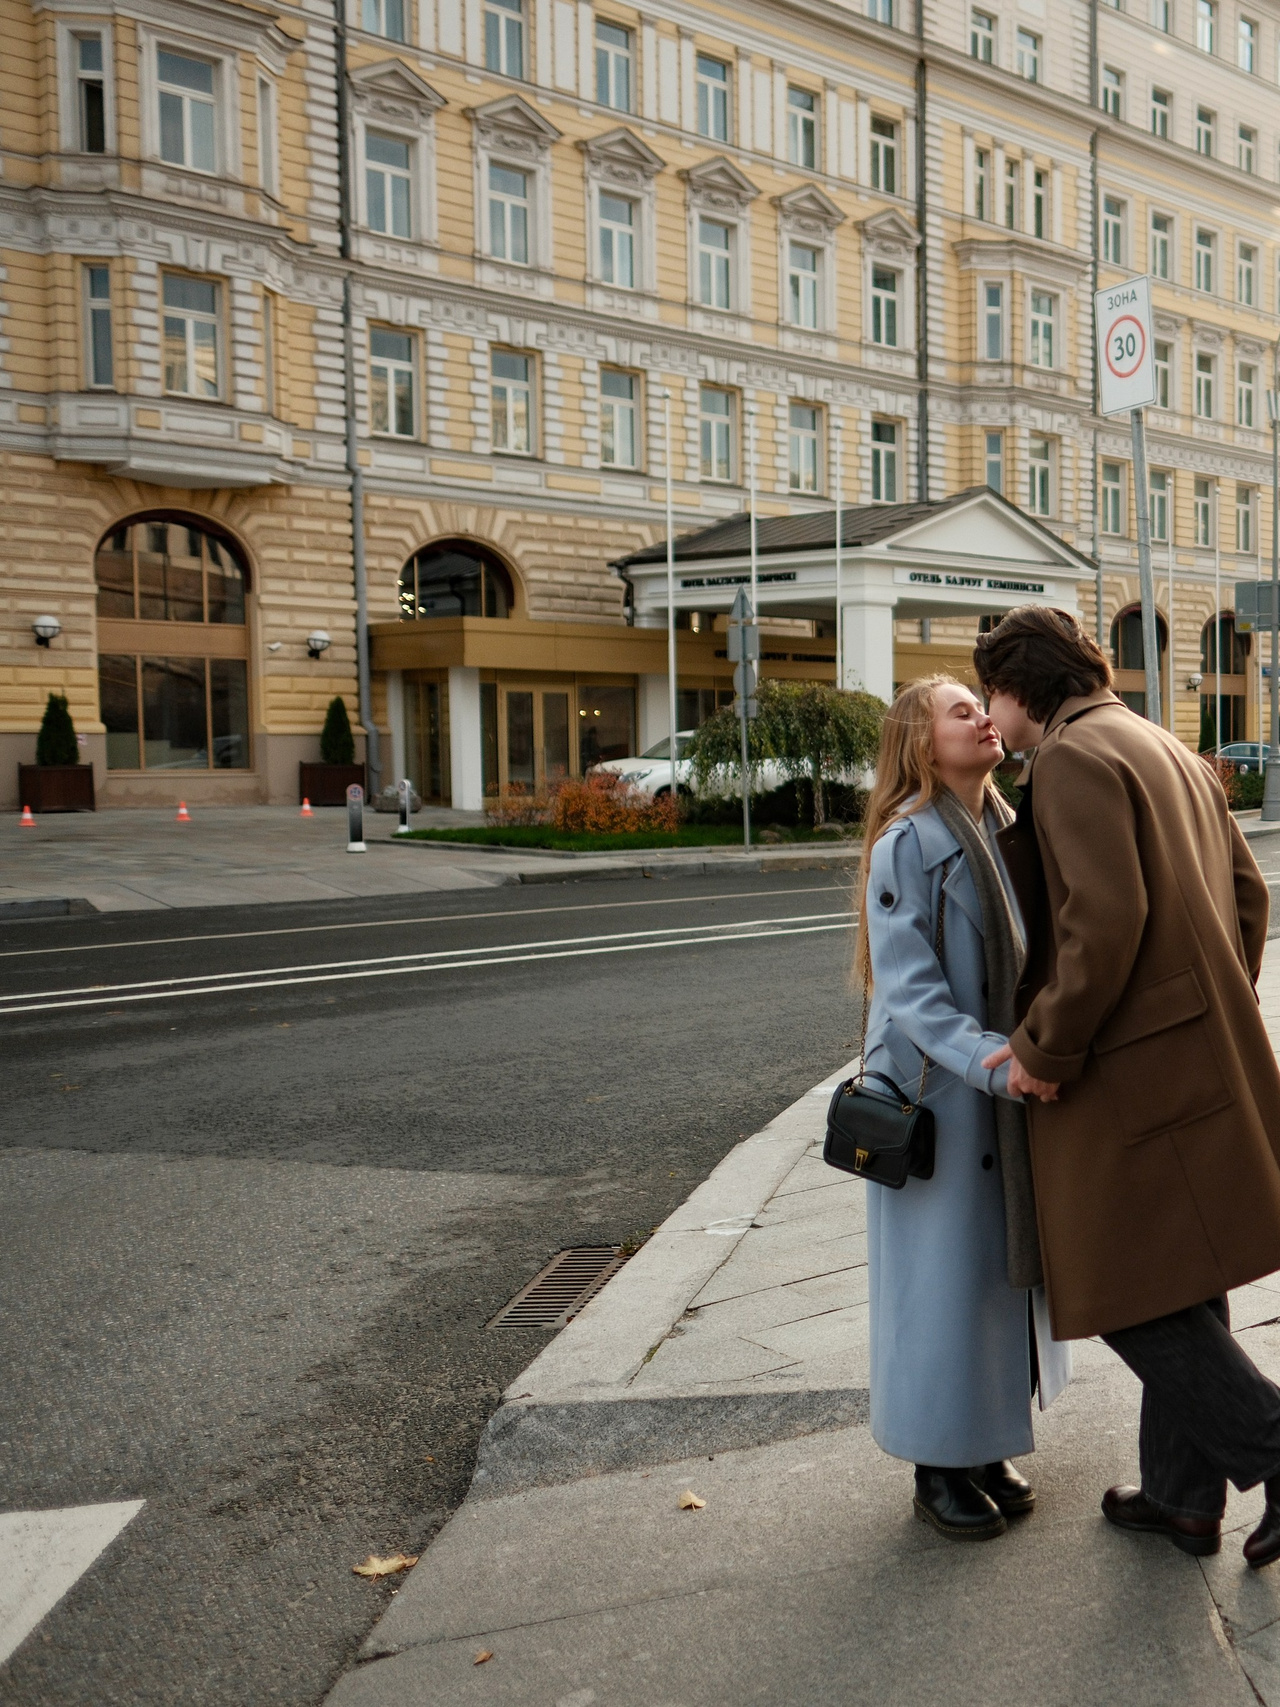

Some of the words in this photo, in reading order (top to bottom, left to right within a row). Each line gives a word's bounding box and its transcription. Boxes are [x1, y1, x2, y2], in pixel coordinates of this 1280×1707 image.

[1107, 289, 1137, 310] ЗОНА
[1114, 333, 1135, 361] 30
[909, 572, 942, 583] ОТЕЛЬ
[945, 575, 983, 587] БАЛЧУГ
[987, 579, 1044, 592] КЕМПИНСКИ
